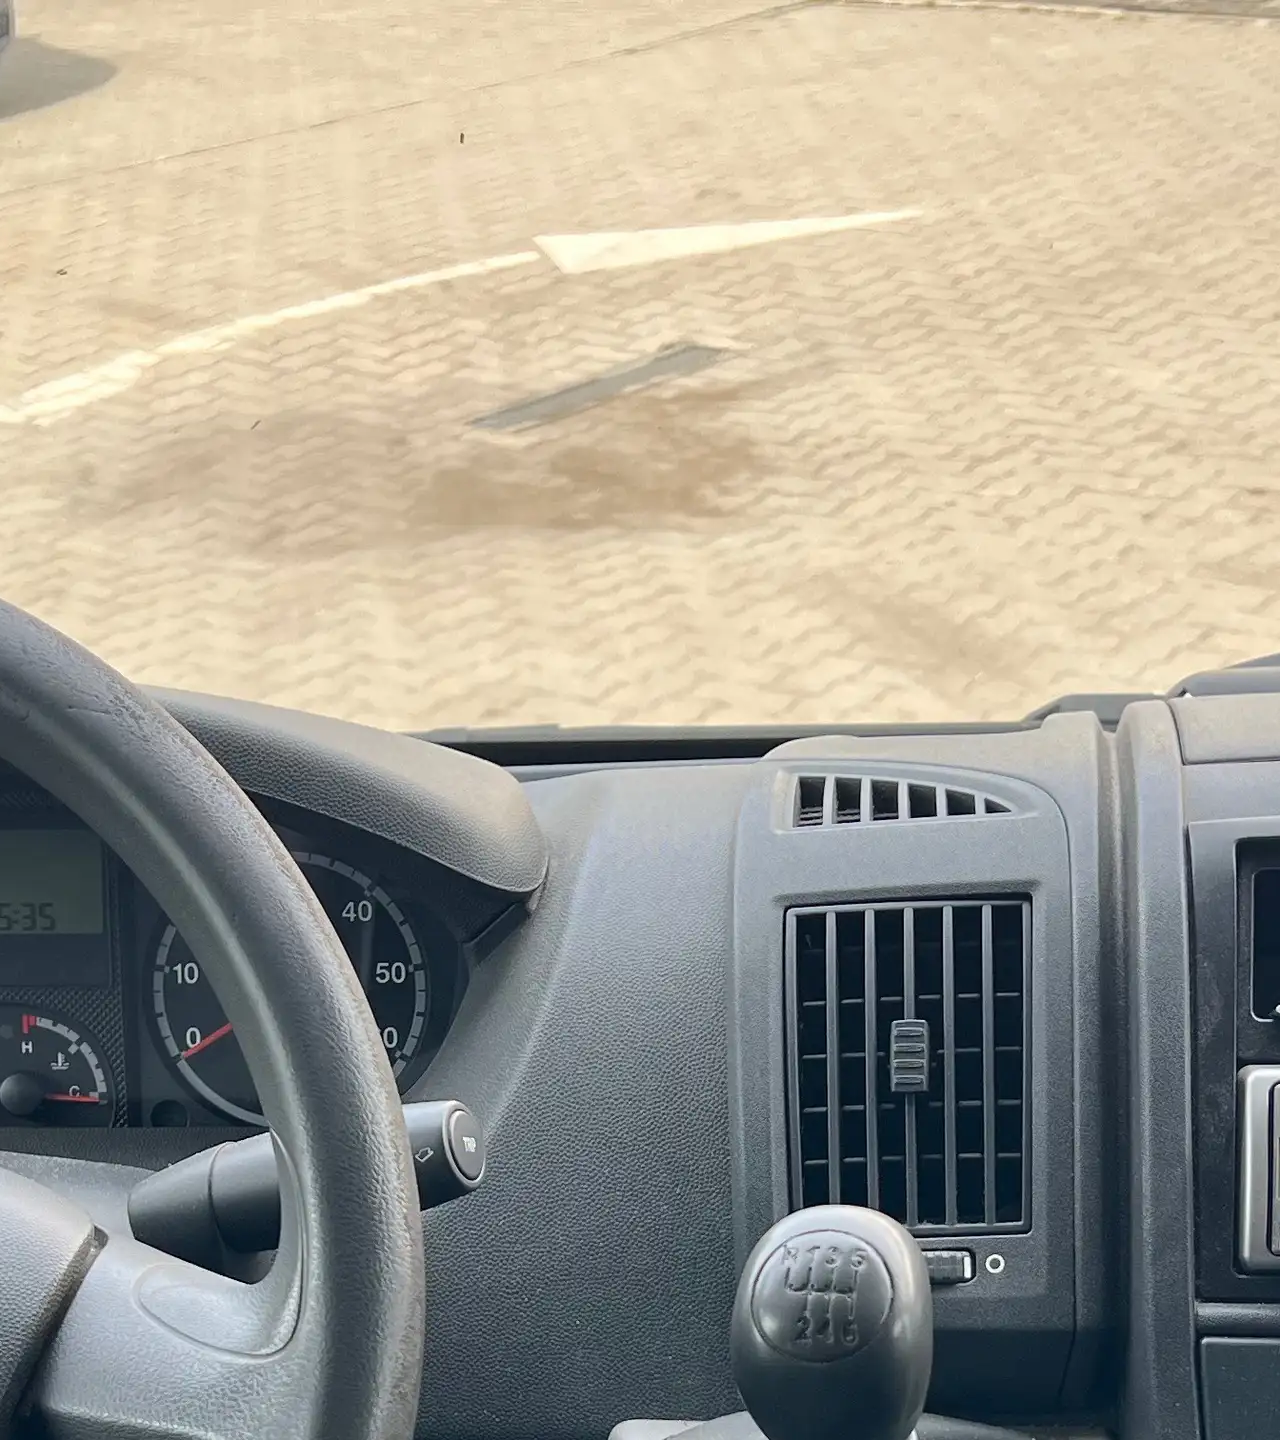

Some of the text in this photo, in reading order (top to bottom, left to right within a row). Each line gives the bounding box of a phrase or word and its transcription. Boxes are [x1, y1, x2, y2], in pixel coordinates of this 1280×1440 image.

[342, 900, 373, 922] 40
[172, 962, 199, 984] 10
[375, 962, 406, 984] 50
[22, 1040, 33, 1054] H
[185, 1027, 201, 1048] 0
[382, 1027, 398, 1048] 0
[68, 1085, 80, 1097] C
